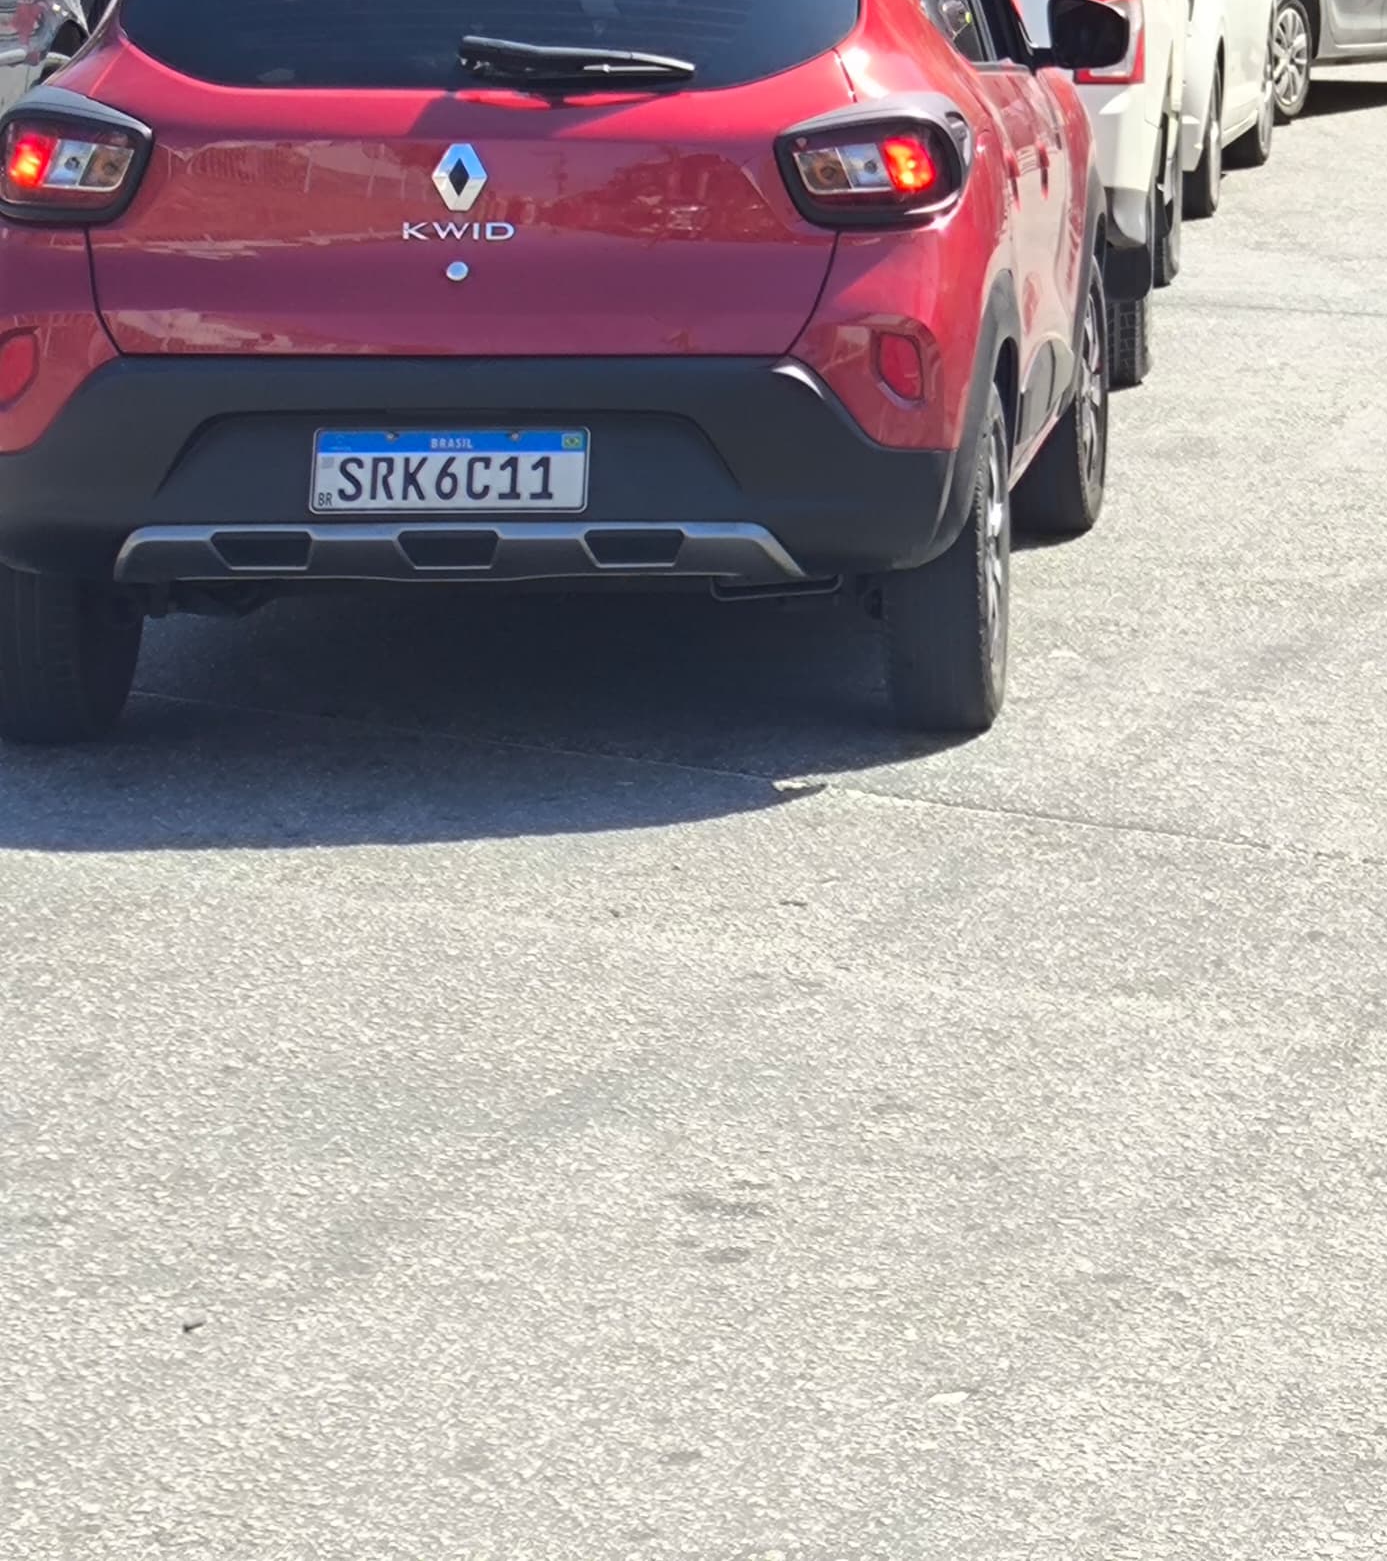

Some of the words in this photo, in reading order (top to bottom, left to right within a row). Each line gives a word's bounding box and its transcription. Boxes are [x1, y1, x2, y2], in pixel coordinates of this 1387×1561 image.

[402, 222, 515, 240] KWID
[430, 438, 474, 450] BRASIL
[337, 456, 554, 502] SRK6C11
[318, 492, 333, 507] BR
